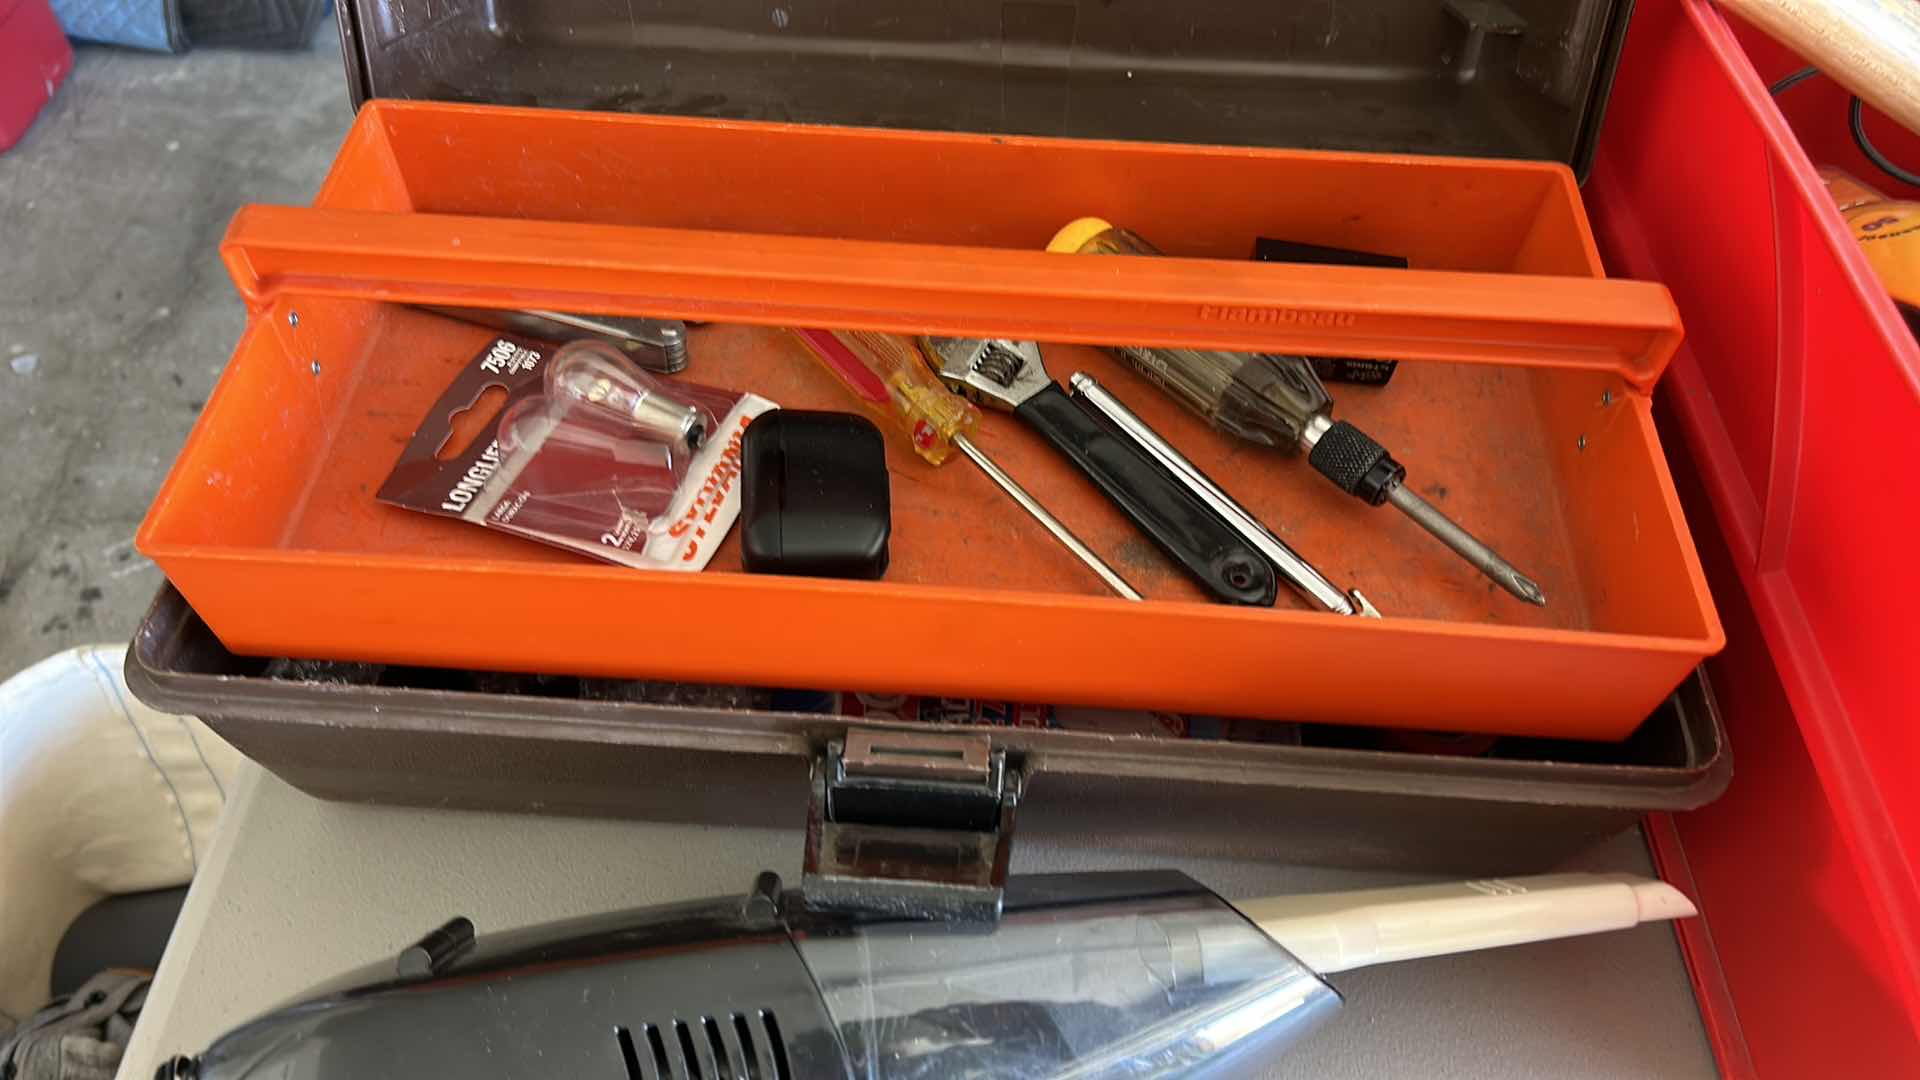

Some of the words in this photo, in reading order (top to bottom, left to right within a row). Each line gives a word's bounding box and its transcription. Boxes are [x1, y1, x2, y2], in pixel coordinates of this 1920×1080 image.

[1199, 303, 1357, 328] Flambeau
[480, 339, 516, 374] 7506
[521, 350, 541, 371] 1073
[441, 439, 500, 513] LONGLIF
